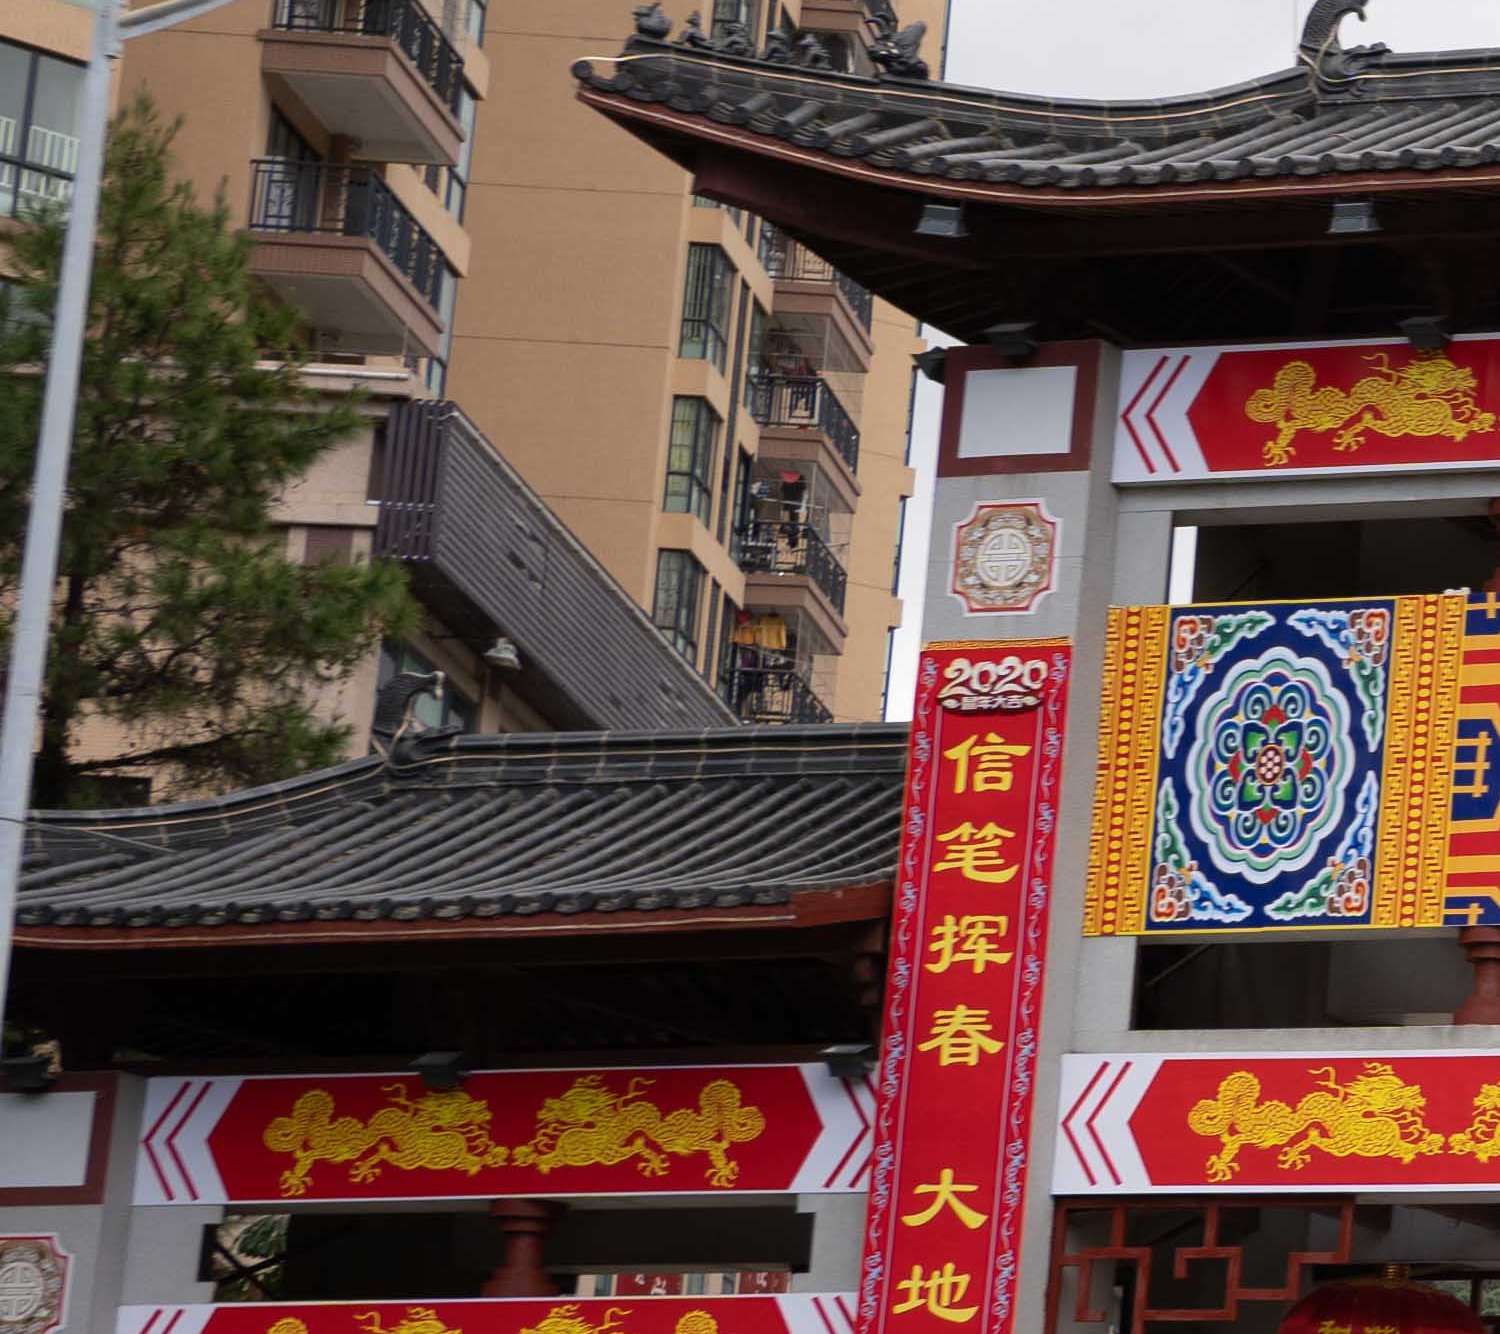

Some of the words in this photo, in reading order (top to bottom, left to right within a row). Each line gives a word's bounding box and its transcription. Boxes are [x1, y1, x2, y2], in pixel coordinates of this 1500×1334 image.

[937, 655, 1049, 699] 2020
[917, 730, 1031, 1068] 信笔挥春
